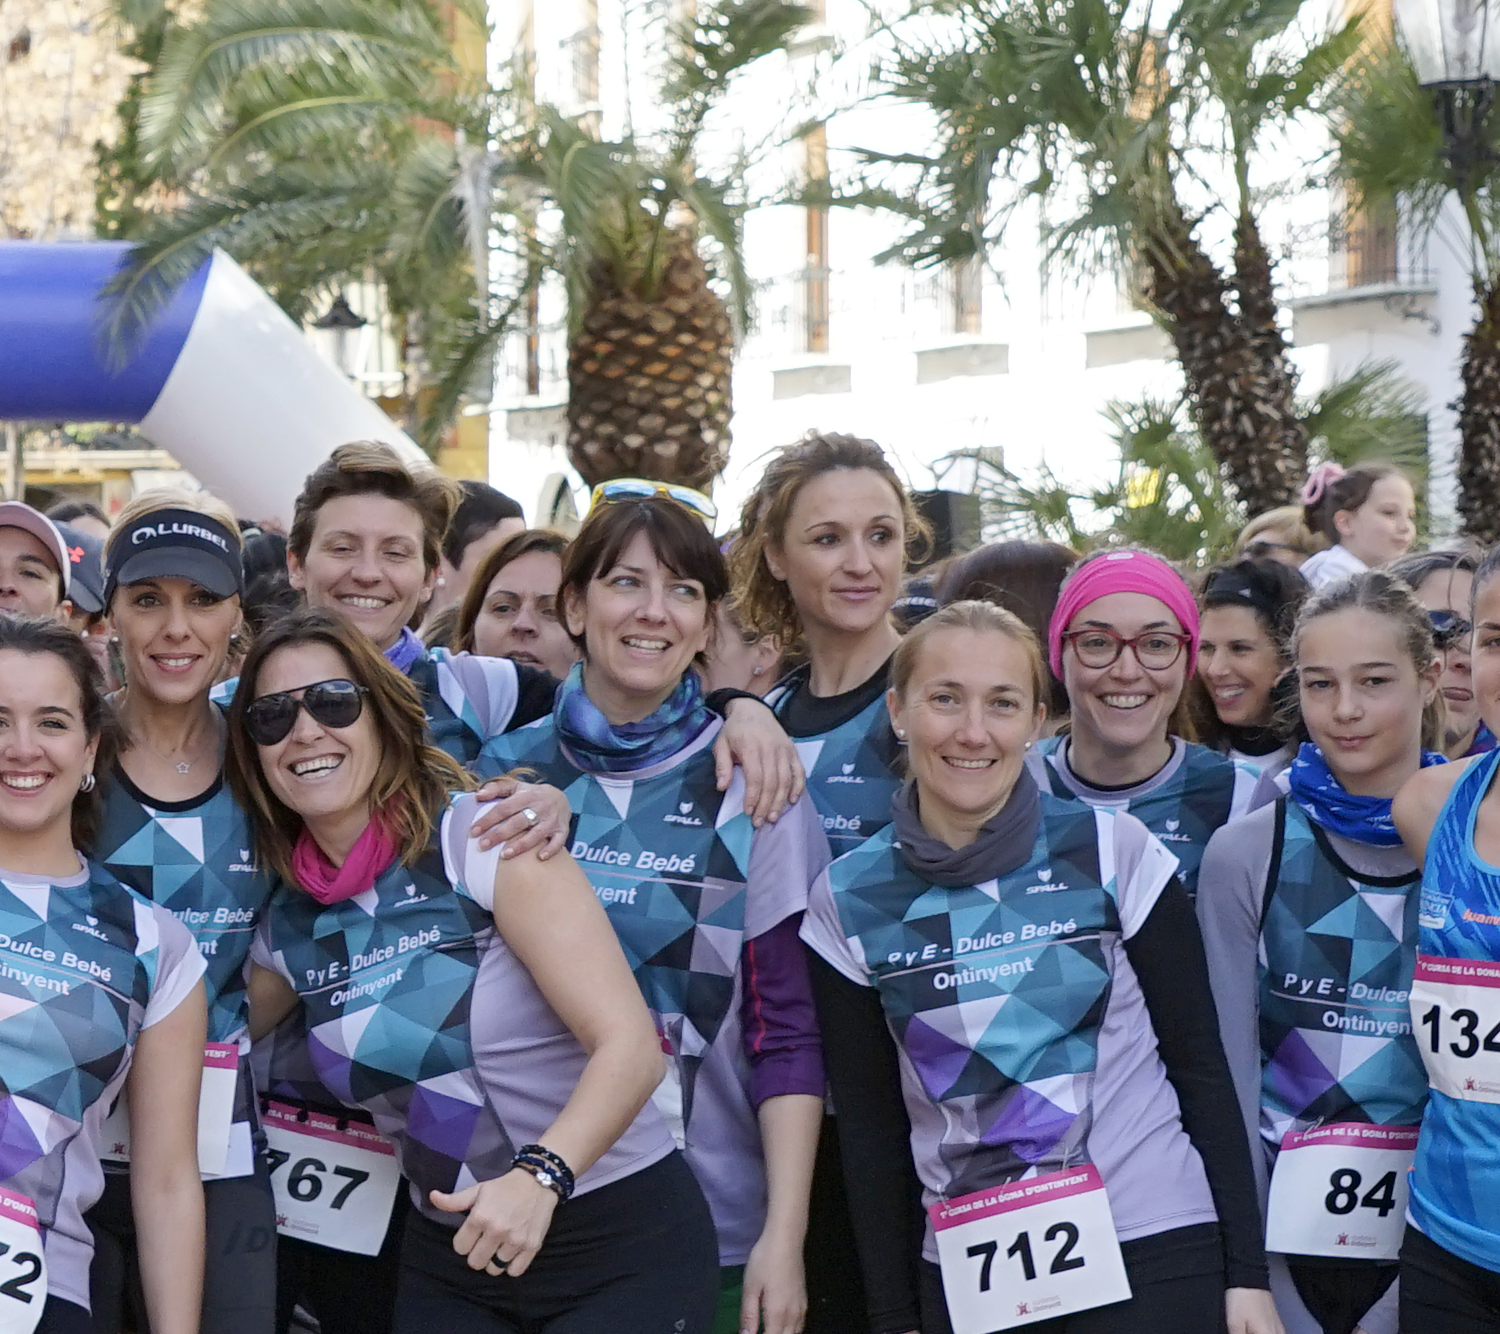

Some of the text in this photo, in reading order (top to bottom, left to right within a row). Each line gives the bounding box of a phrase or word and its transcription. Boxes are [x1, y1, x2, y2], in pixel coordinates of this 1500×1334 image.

[158, 522, 230, 553] LURBEL
[570, 839, 696, 873] Dulce Bebé
[1025, 882, 1069, 896] SPALL
[213, 906, 254, 923] Bebé
[71, 922, 110, 943] SPALL
[351, 946, 395, 972] Dulce
[397, 923, 442, 954] Bebé
[955, 931, 1015, 954] Dulce
[1020, 917, 1078, 941] Bebé
[61, 951, 113, 982] Bebé
[932, 956, 1035, 990] Ontinyent
[1463, 966, 1476, 976] LA
[1477, 968, 1500, 978] DONA
[329, 967, 403, 1007] Ontinyent
[1350, 982, 1410, 1003] Dulce
[1322, 1010, 1412, 1035] Ontinyen
[984, 1197, 997, 1207] LA
[1324, 1167, 1398, 1217] 84
[966, 1221, 1086, 1293] 712
